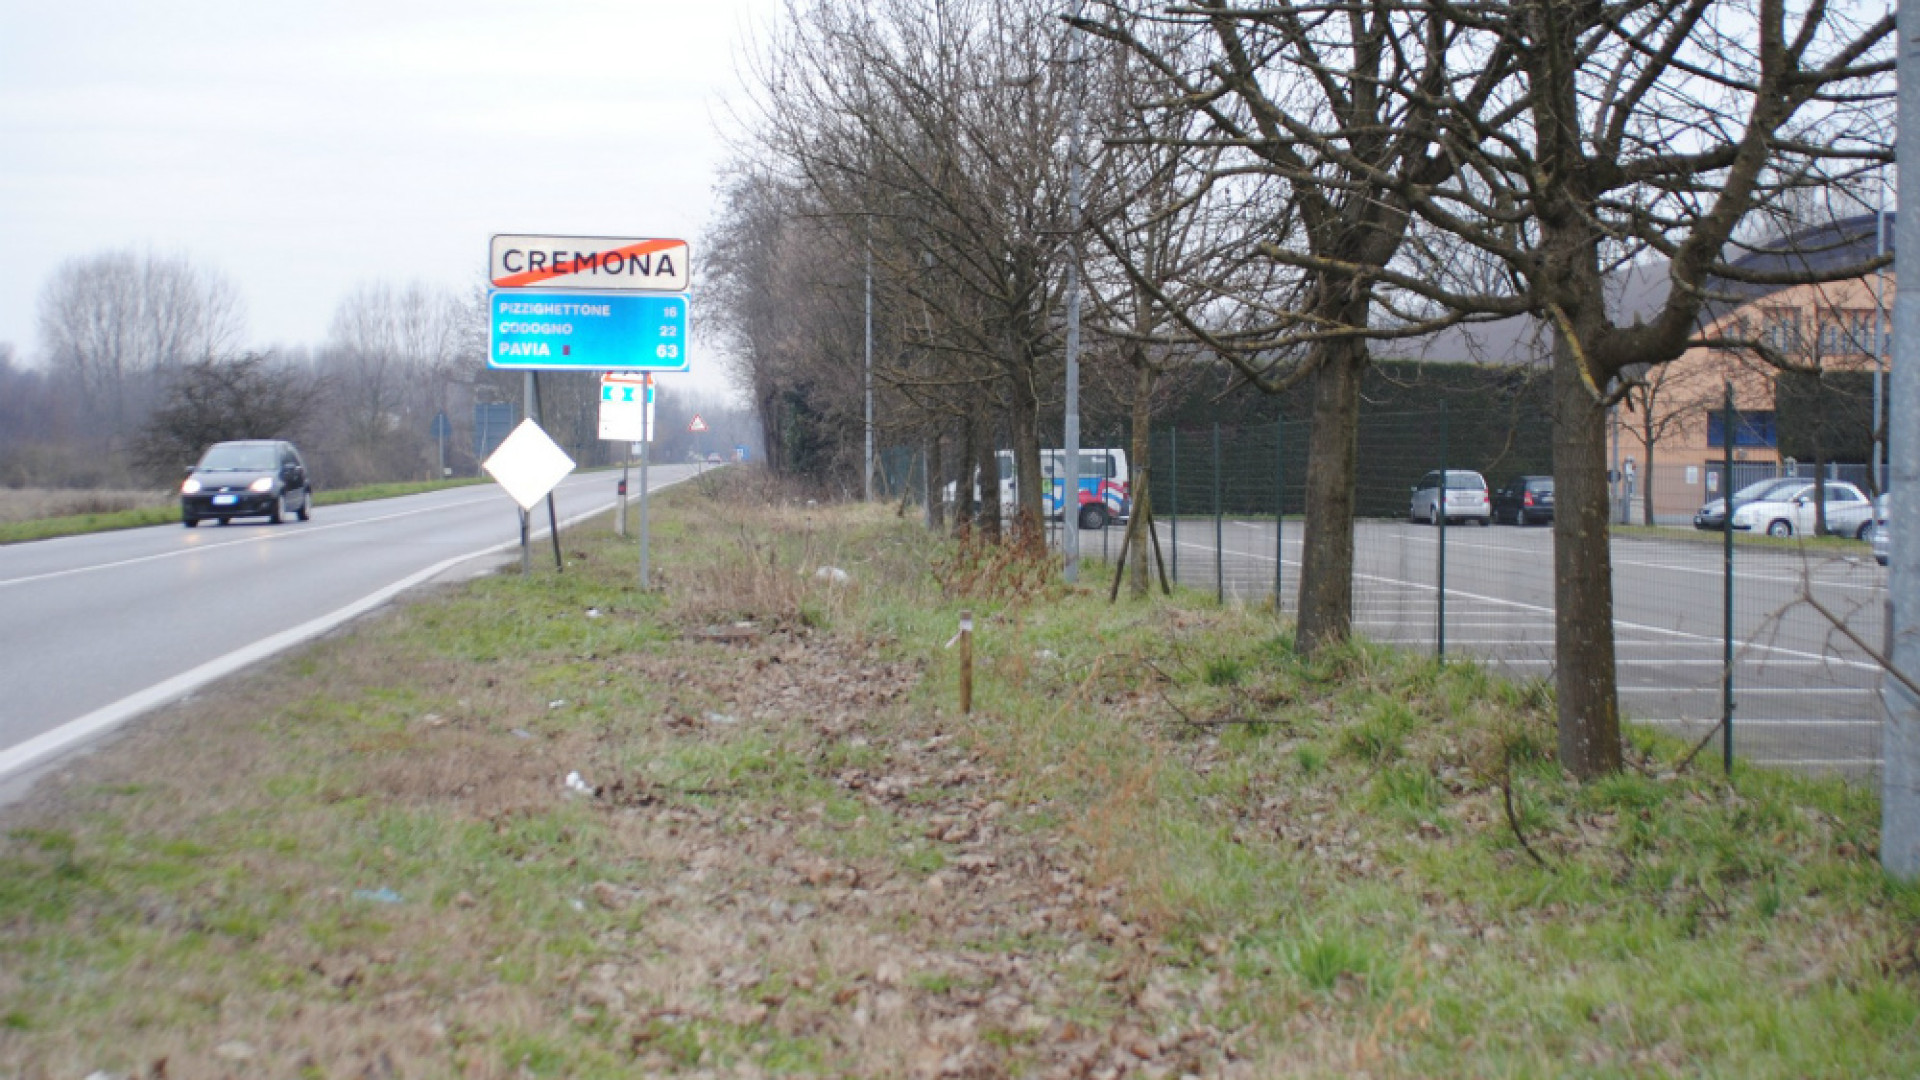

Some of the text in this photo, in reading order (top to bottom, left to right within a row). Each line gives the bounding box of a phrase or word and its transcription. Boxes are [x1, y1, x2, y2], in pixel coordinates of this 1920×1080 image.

[502, 249, 677, 277] CREMONA
[500, 302, 677, 318] PIZZIGHETTONE 16
[499, 322, 677, 337] CODOGNO 22
[499, 342, 679, 358] PAVIA 63
